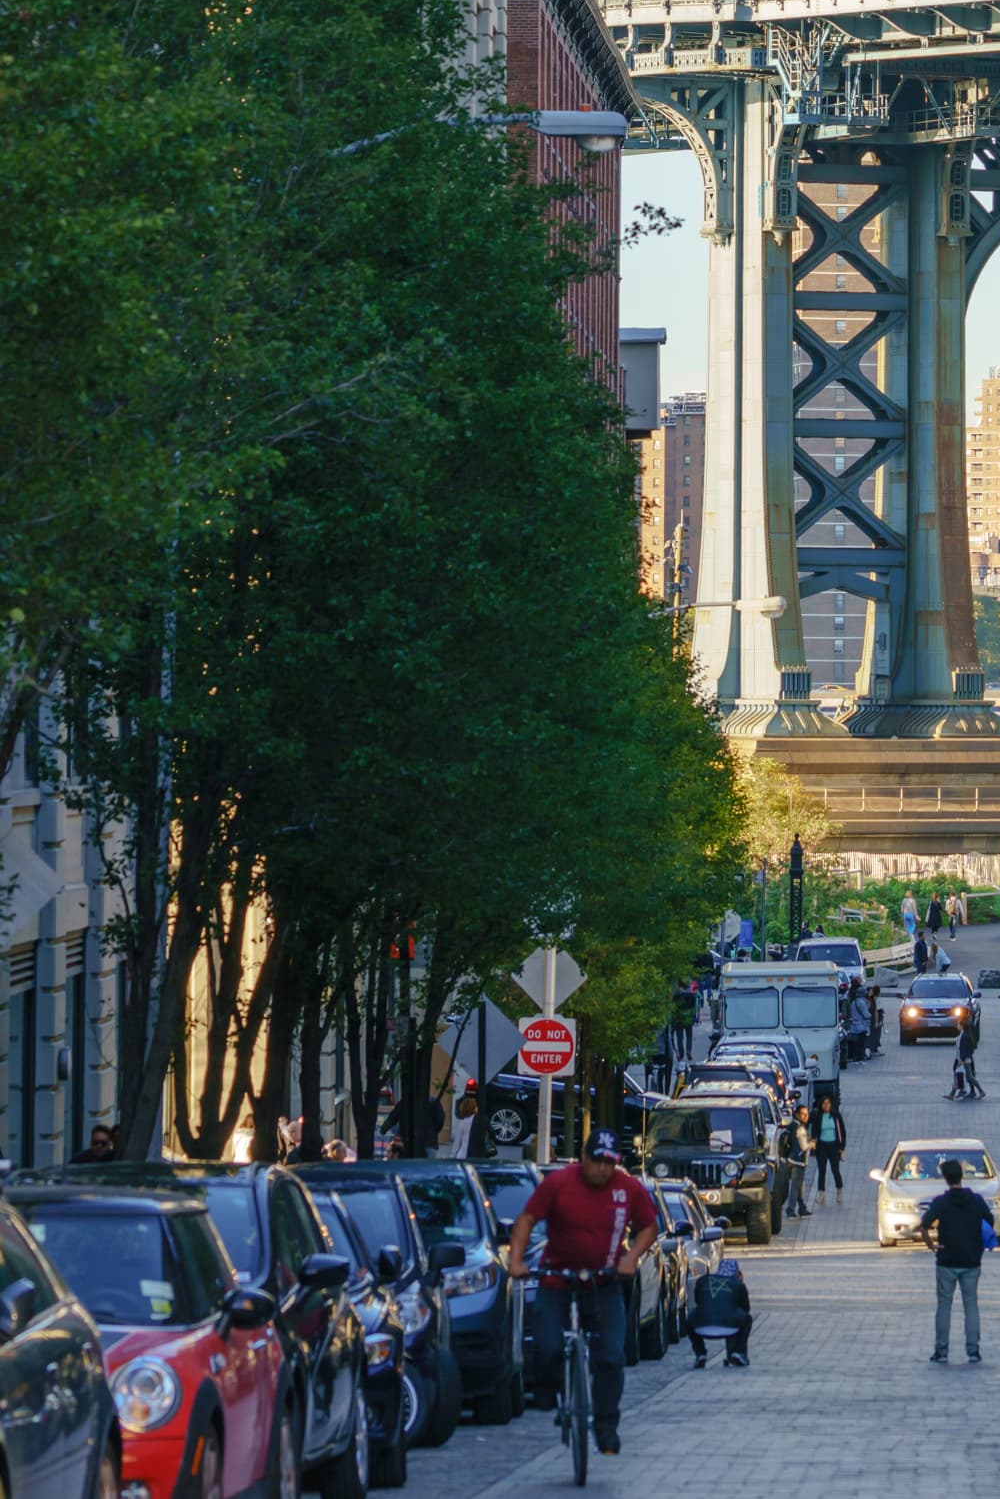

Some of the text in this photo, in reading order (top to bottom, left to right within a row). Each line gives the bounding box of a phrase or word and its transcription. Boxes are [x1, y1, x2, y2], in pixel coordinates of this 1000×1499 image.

[528, 1030, 566, 1039] DO NOT
[531, 1054, 562, 1063] ENTER
